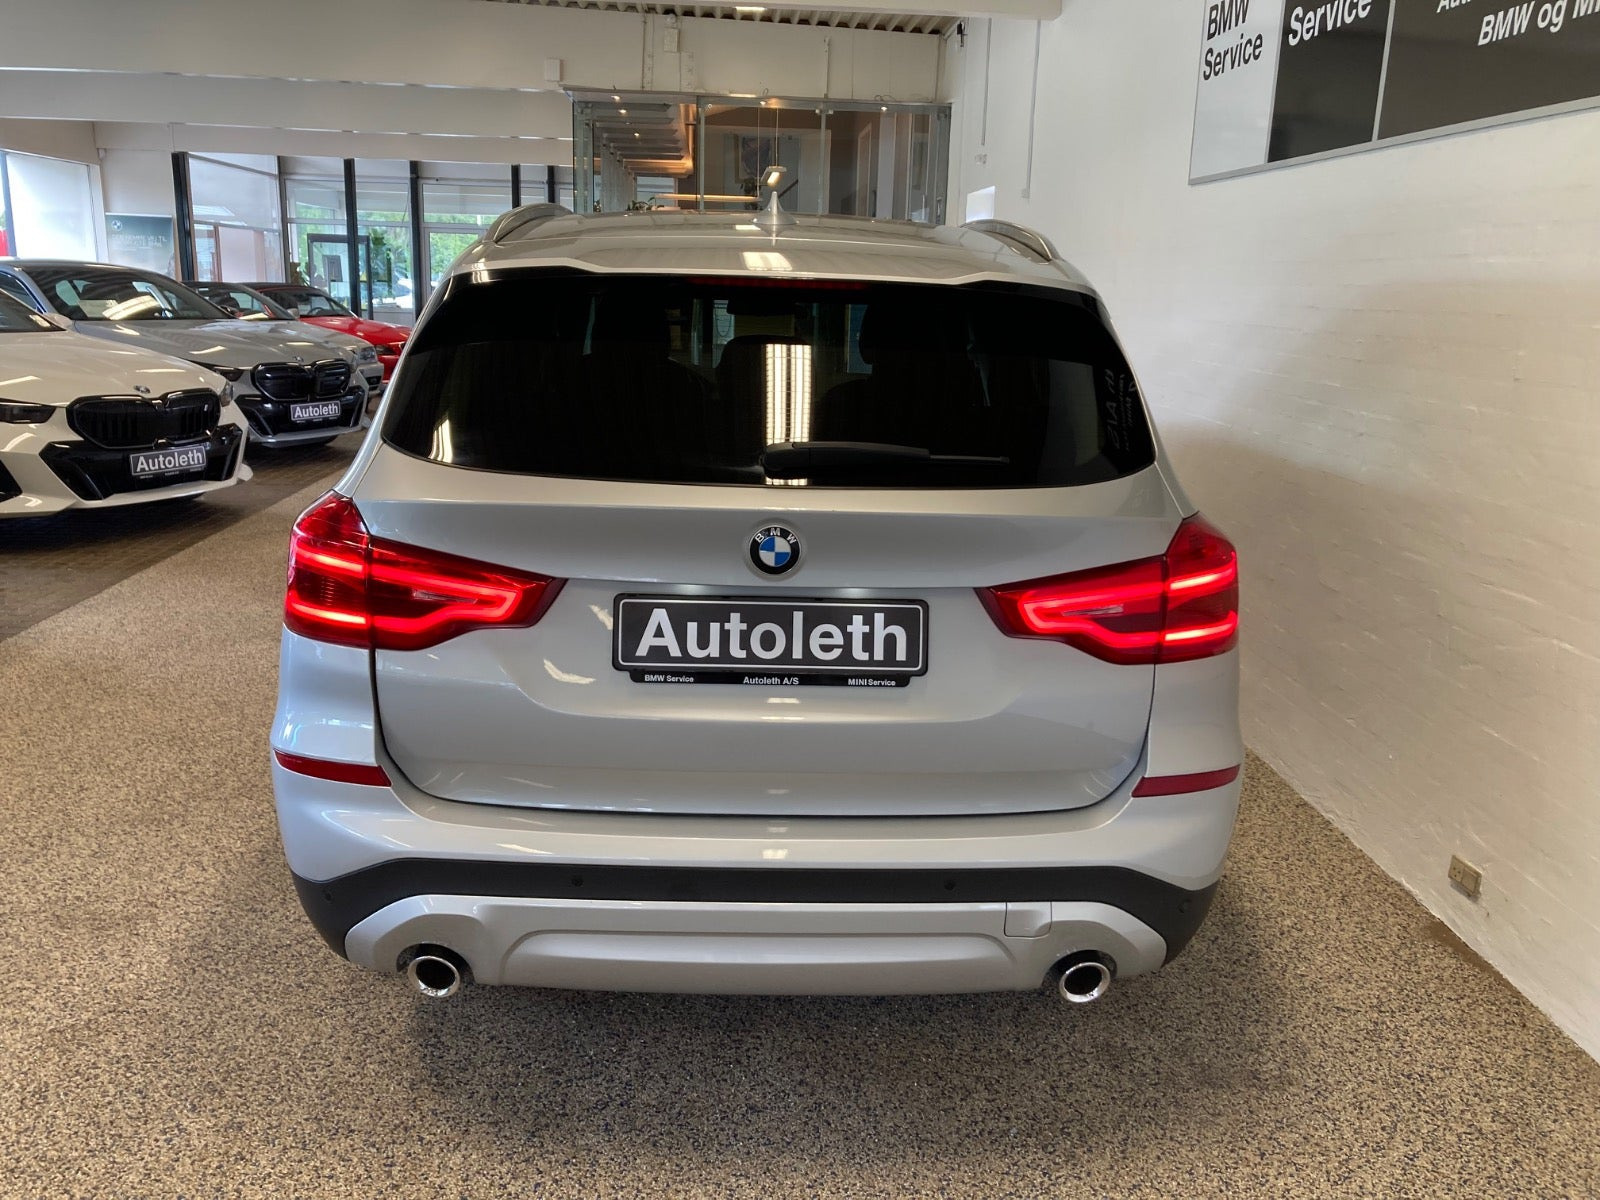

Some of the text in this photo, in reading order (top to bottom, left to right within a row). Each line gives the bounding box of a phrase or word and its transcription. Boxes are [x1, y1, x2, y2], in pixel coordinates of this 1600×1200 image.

[1207, 0, 1249, 41] BMW
[1289, 0, 1372, 46] Service
[1478, 1, 1535, 46] BMW
[1537, 0, 1567, 33] og
[1203, 33, 1263, 81] Service
[294, 403, 338, 418] Autoleth
[136, 449, 203, 472] Autoleth
[755, 527, 797, 544] BMW
[635, 608, 907, 661] Autoleth
[644, 674, 694, 683] BMW Service
[743, 676, 799, 685] Autoleth A/S
[848, 678, 896, 686] MINI Service
